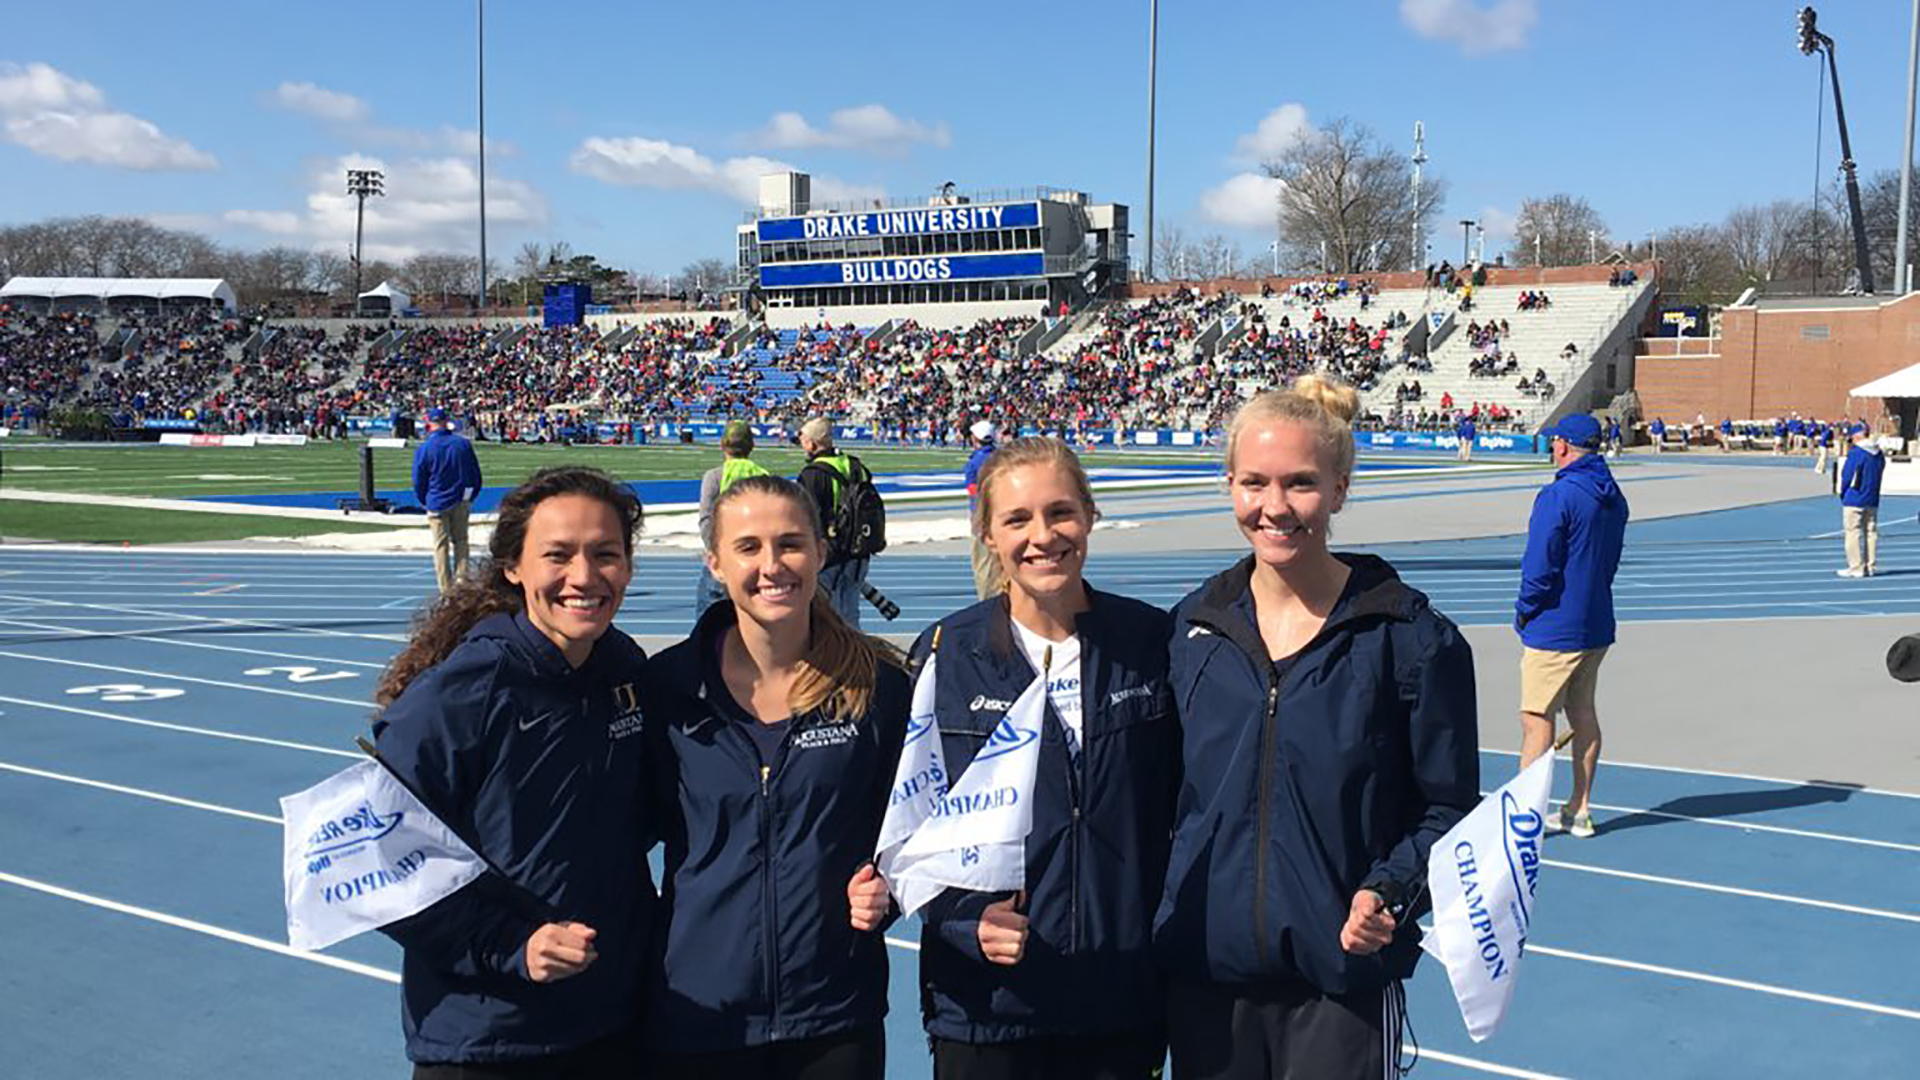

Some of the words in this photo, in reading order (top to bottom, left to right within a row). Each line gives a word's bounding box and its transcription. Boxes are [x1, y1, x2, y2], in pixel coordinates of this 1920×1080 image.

[804, 215, 869, 238] DRAKE
[878, 207, 1003, 233] UNIVERSITY
[842, 259, 951, 282] BULLDOGS
[243, 666, 360, 683] 2
[65, 683, 186, 702] 3
[1454, 840, 1508, 981] CHAMPION
